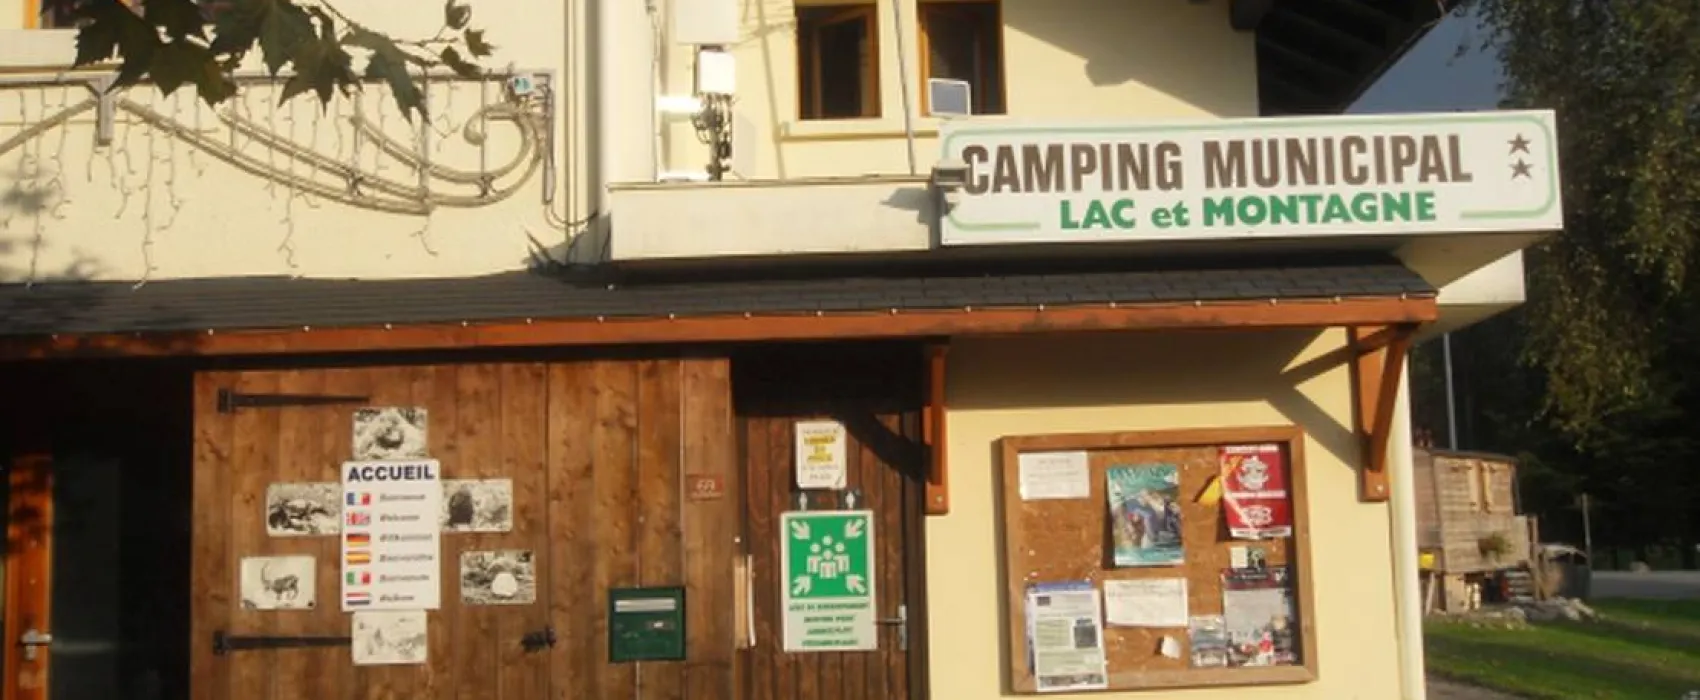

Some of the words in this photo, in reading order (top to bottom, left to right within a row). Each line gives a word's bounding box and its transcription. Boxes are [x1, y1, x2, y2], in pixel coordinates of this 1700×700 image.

[962, 141, 1183, 195] CAMPING
[1202, 133, 1473, 189] MUNICIPAL
[1060, 199, 1136, 229] LAC
[1151, 200, 1190, 228] et
[1202, 191, 1437, 227] MONTAGNE
[348, 465, 434, 482] ACCUEIL
